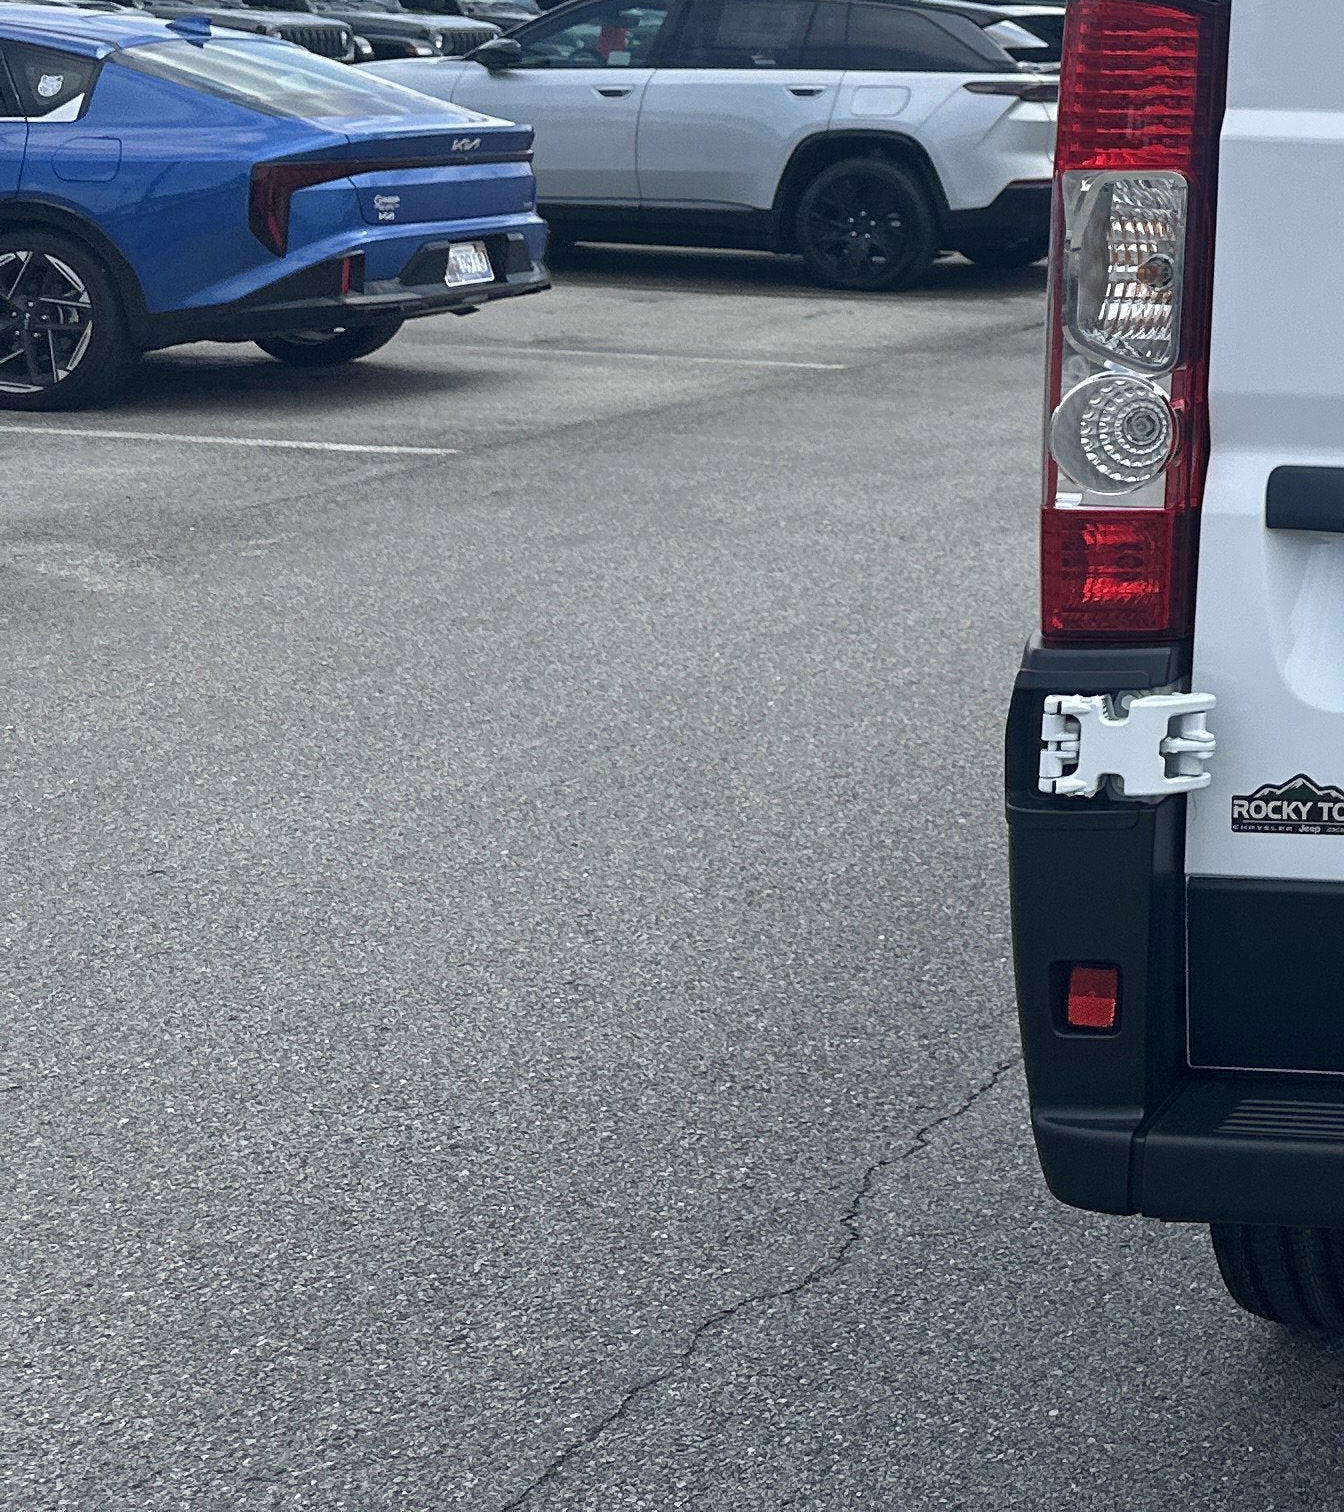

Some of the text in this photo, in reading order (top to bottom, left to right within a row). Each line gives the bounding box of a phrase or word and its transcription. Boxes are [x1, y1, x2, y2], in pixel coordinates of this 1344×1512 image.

[1232, 799, 1314, 820] ROCKY
[1232, 824, 1293, 832] CHRYSLER
[1298, 824, 1321, 834] Jeep
